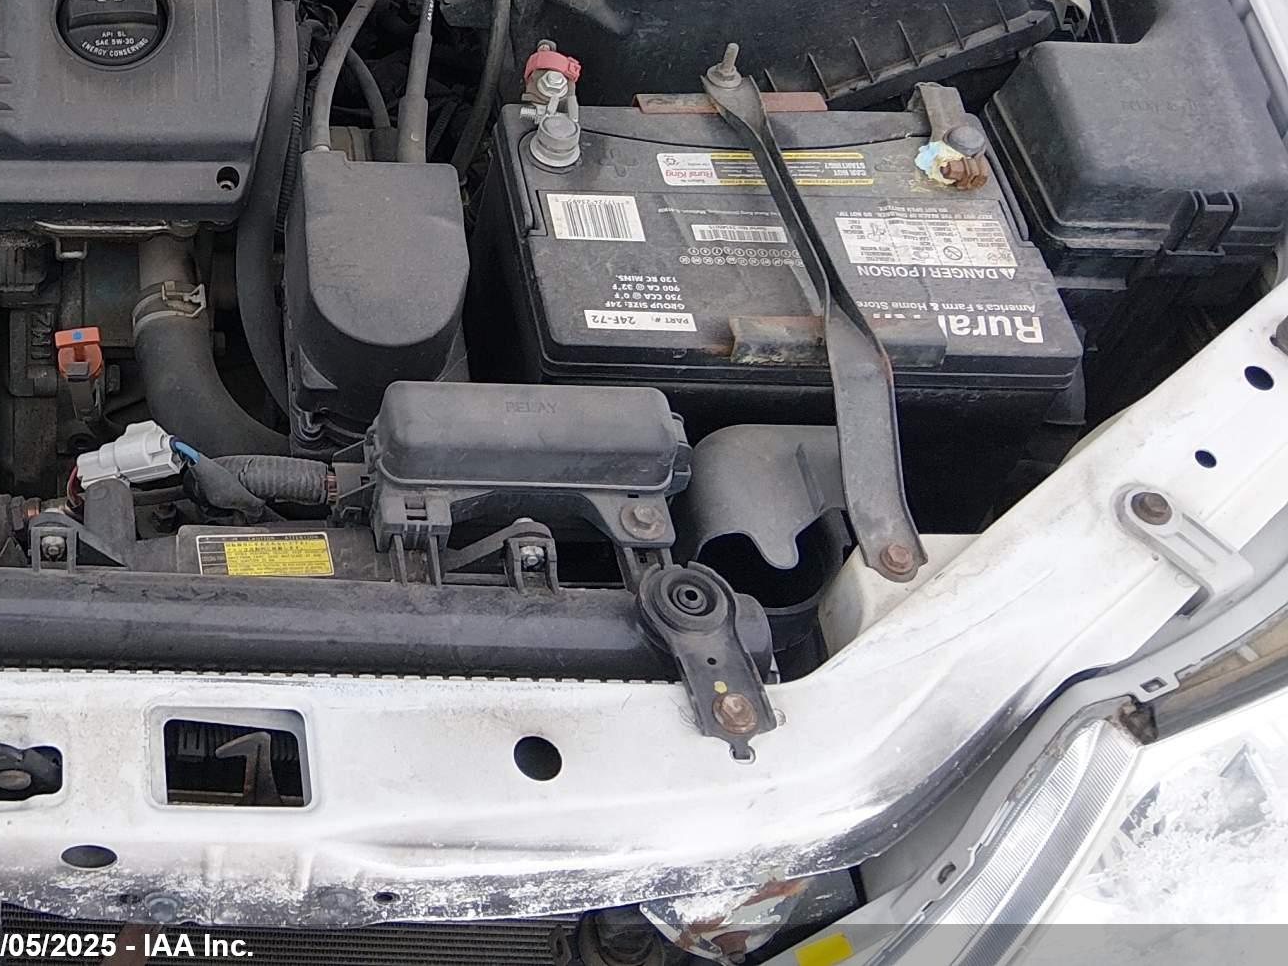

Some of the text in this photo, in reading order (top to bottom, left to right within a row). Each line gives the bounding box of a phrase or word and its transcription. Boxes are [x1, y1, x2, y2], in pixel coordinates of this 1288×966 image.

[81, 38, 148, 57] ENERGY CONSERVING
[664, 168, 687, 178] King
[856, 265, 918, 276] POISON
[929, 267, 999, 280] DANGER
[632, 292, 641, 300] @
[650, 302, 685, 310] GROUP
[855, 300, 1035, 313] America's Farm & Home Store
[591, 315, 636, 325] 24F-72
[665, 317, 689, 325] PART
